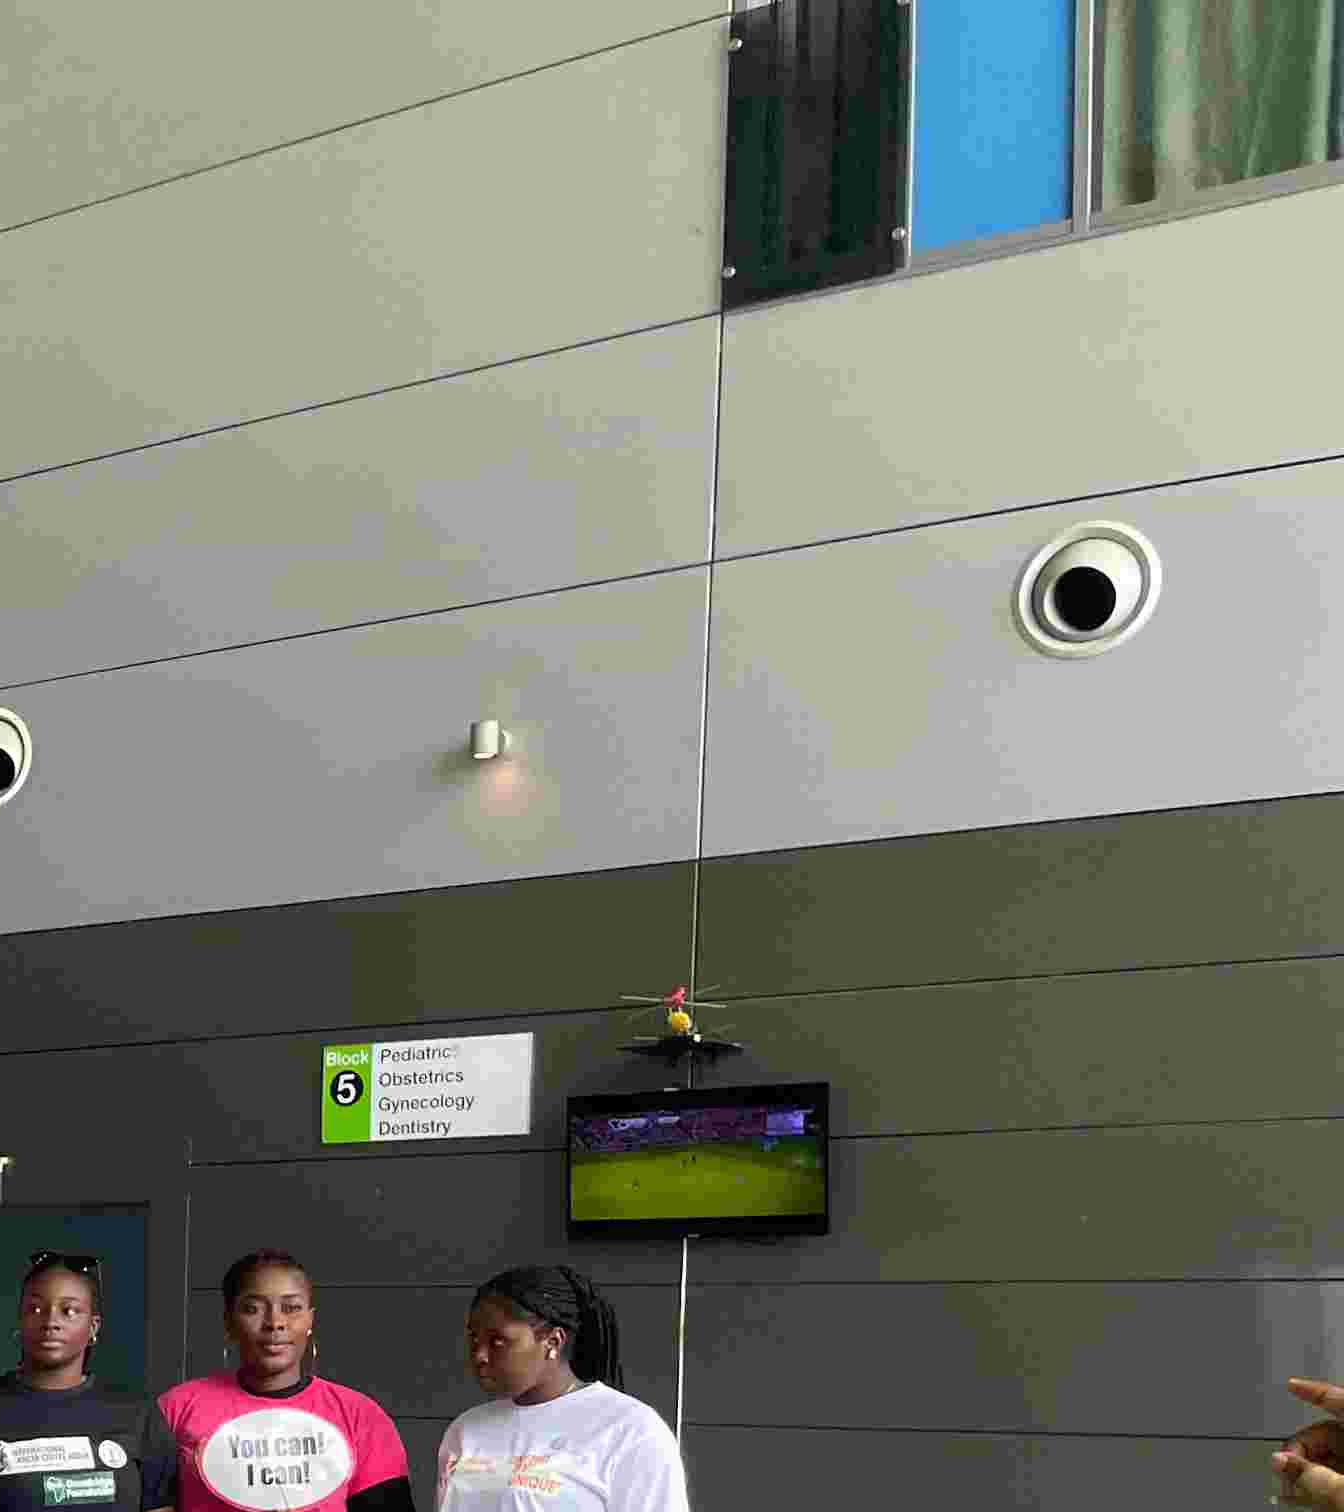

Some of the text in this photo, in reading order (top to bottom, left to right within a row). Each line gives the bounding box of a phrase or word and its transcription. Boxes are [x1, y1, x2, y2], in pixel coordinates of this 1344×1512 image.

[326, 1050, 369, 1067] Block
[336, 1073, 356, 1104] 5
[379, 1070, 464, 1087] Obstetrics
[378, 1094, 475, 1114] Gynecology
[379, 1120, 452, 1136] Dentistry
[228, 1431, 325, 1458] You can!
[247, 1460, 312, 1486] I can!
